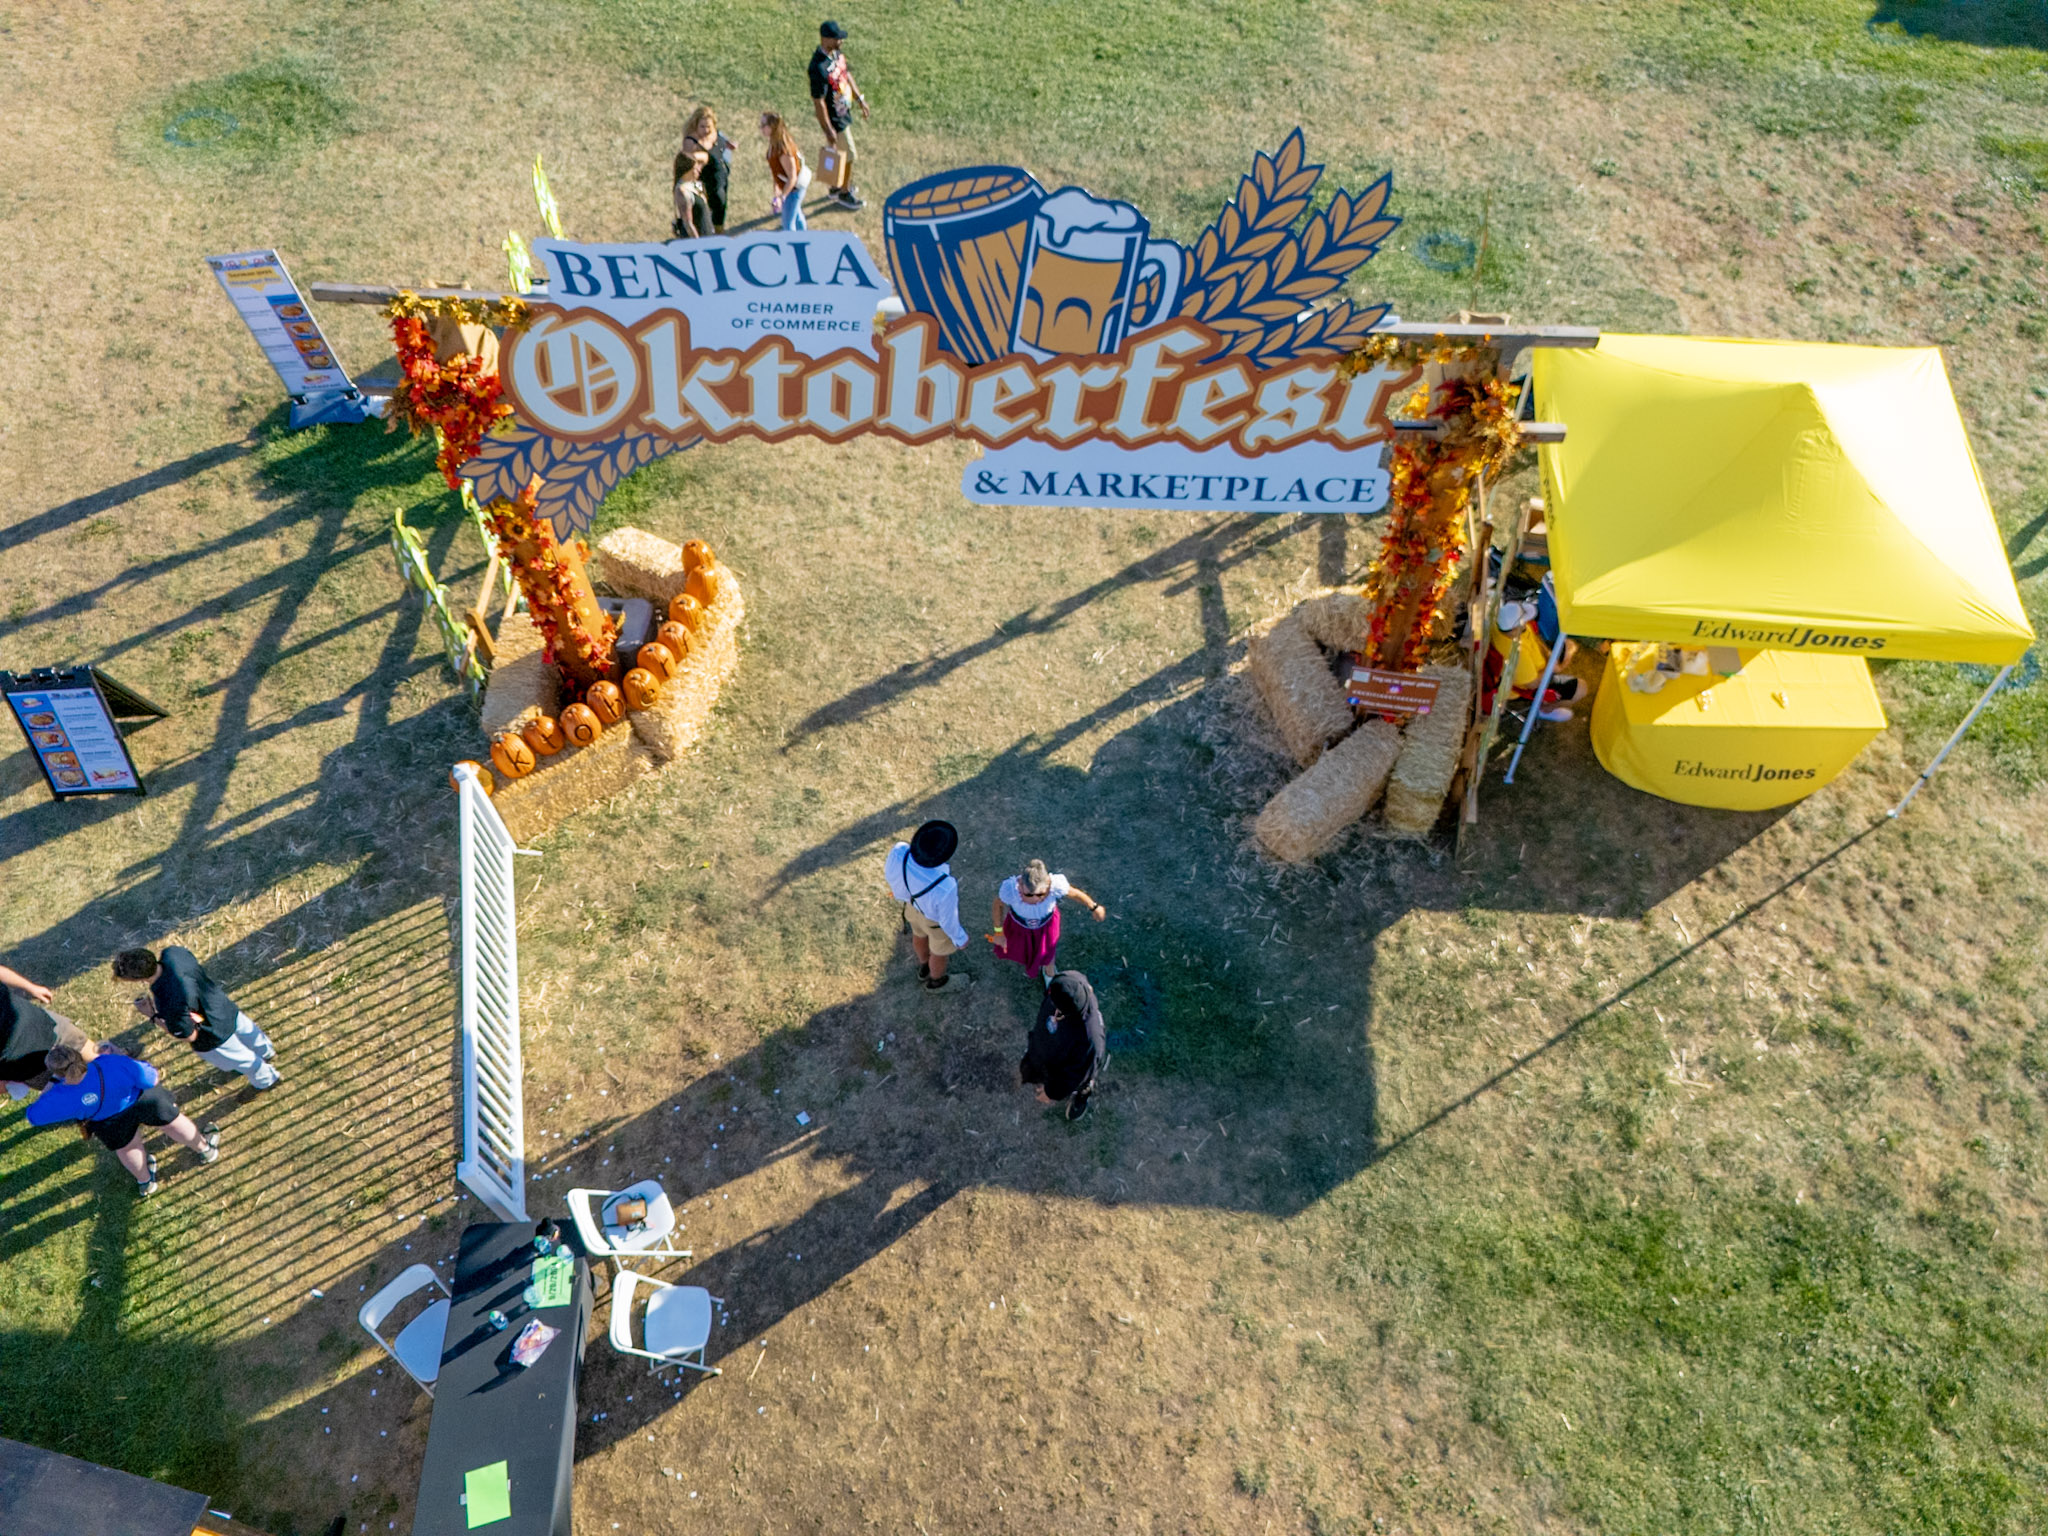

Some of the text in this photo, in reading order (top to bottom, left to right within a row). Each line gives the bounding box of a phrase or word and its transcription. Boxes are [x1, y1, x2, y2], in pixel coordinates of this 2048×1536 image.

[546, 241, 879, 299] BENICIA
[731, 317, 755, 329] OF
[747, 302, 834, 315] CHAMBER
[507, 314, 1412, 449] Oktoberfest
[974, 470, 1377, 504] & MARKETPLACE
